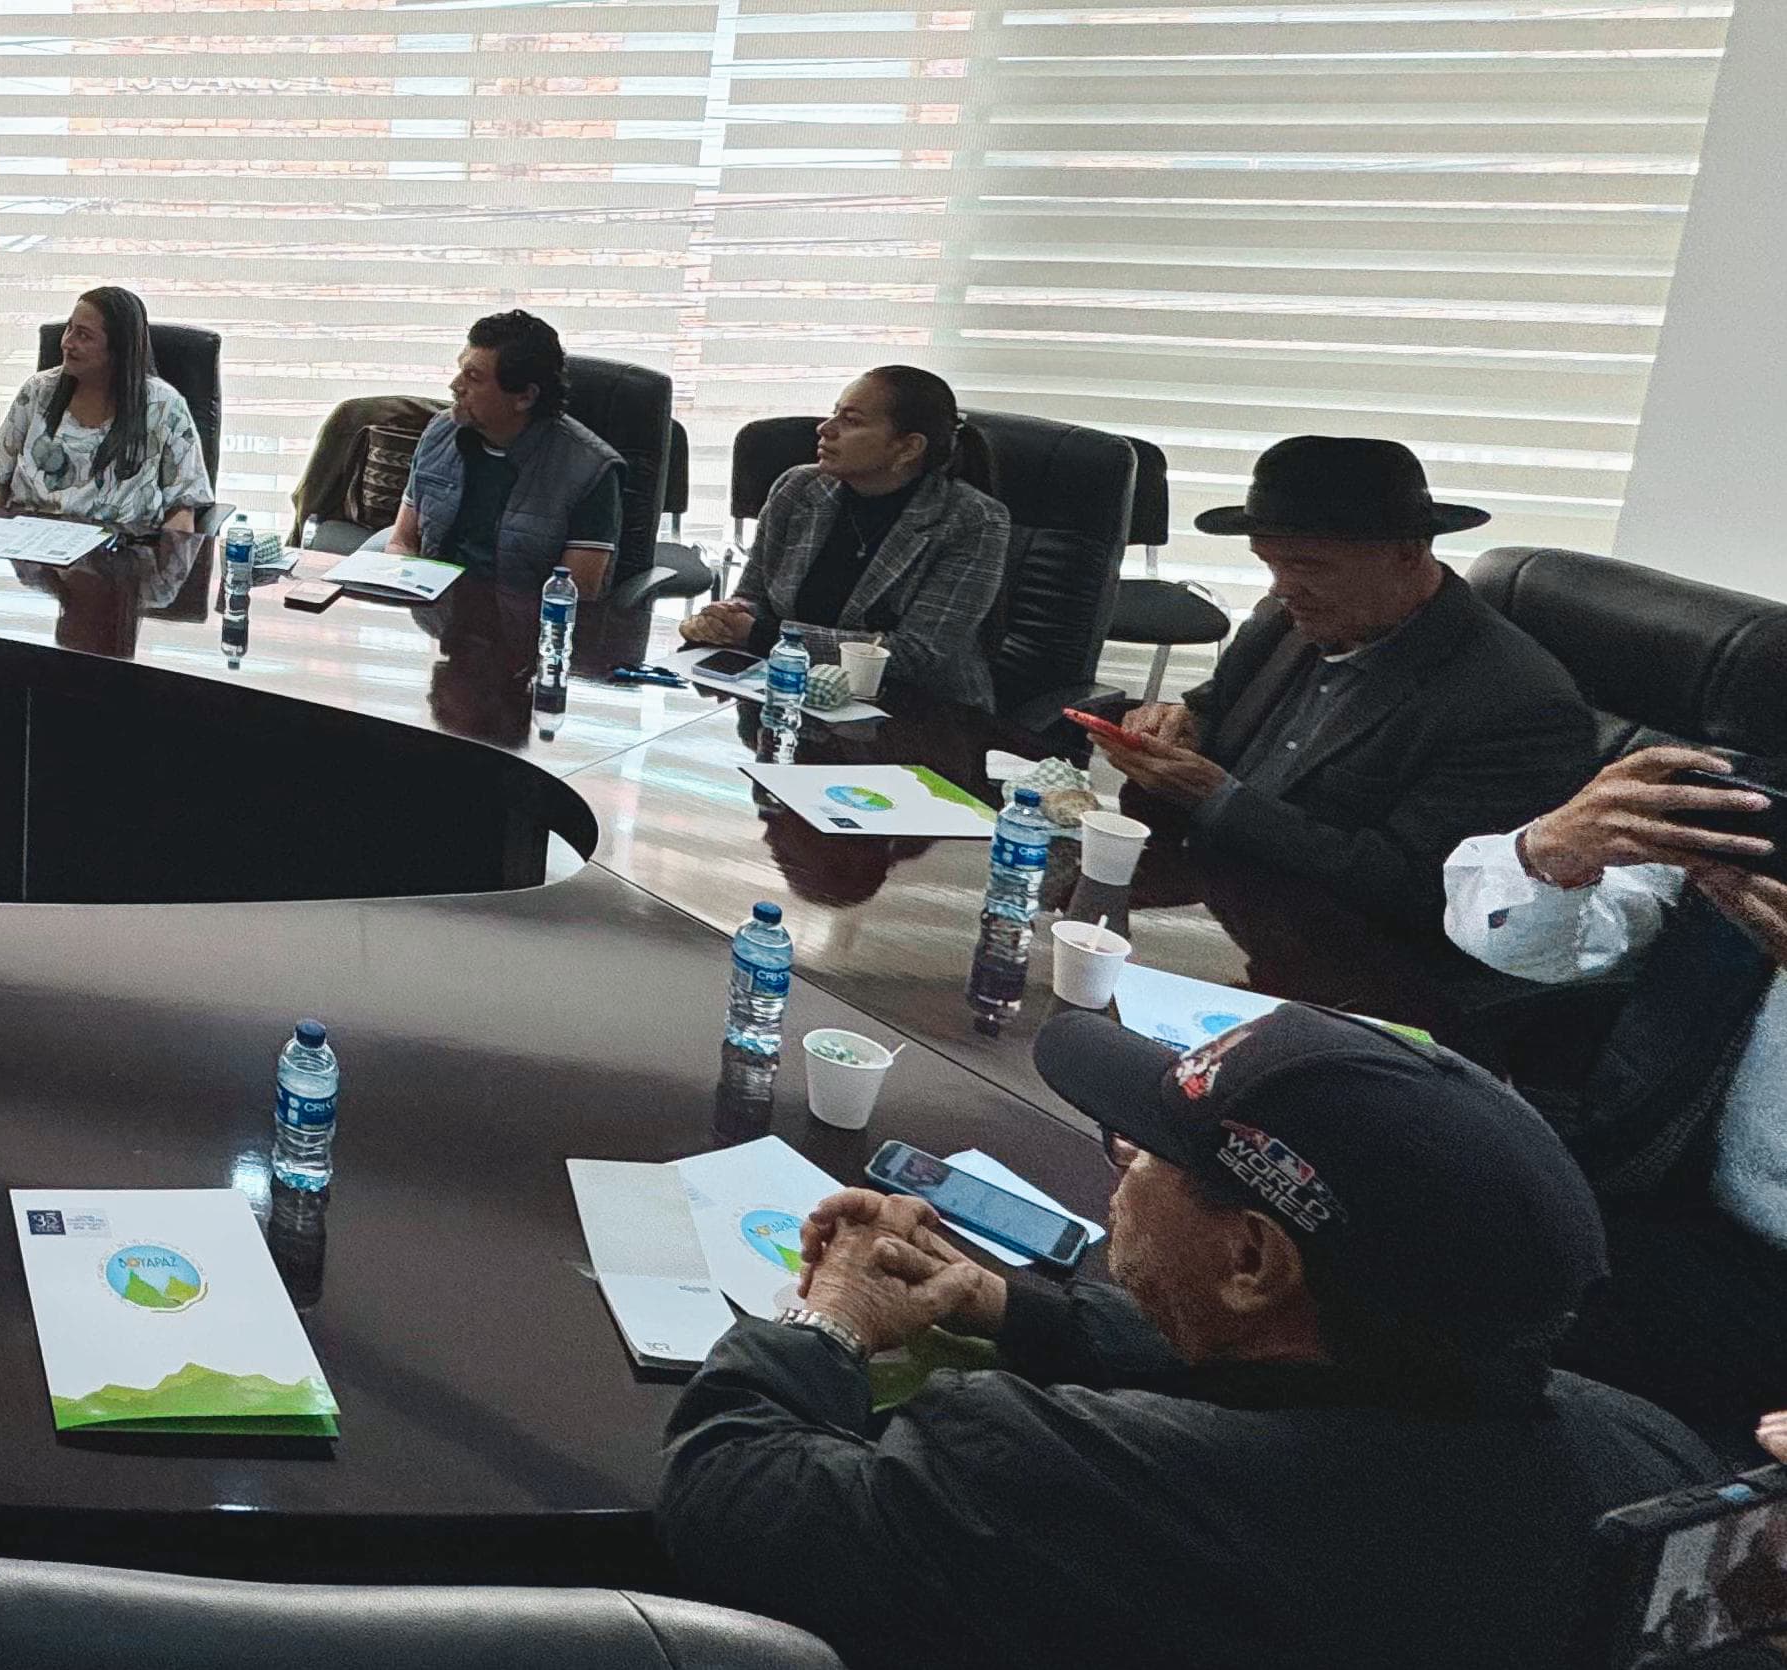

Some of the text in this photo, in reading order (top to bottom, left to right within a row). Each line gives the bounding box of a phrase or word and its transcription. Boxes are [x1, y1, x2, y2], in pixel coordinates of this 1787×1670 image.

[1216, 1147, 1319, 1232] SERIES
[1227, 1132, 1330, 1220] WORLD
[117, 1255, 178, 1269] BOYAPAZ
